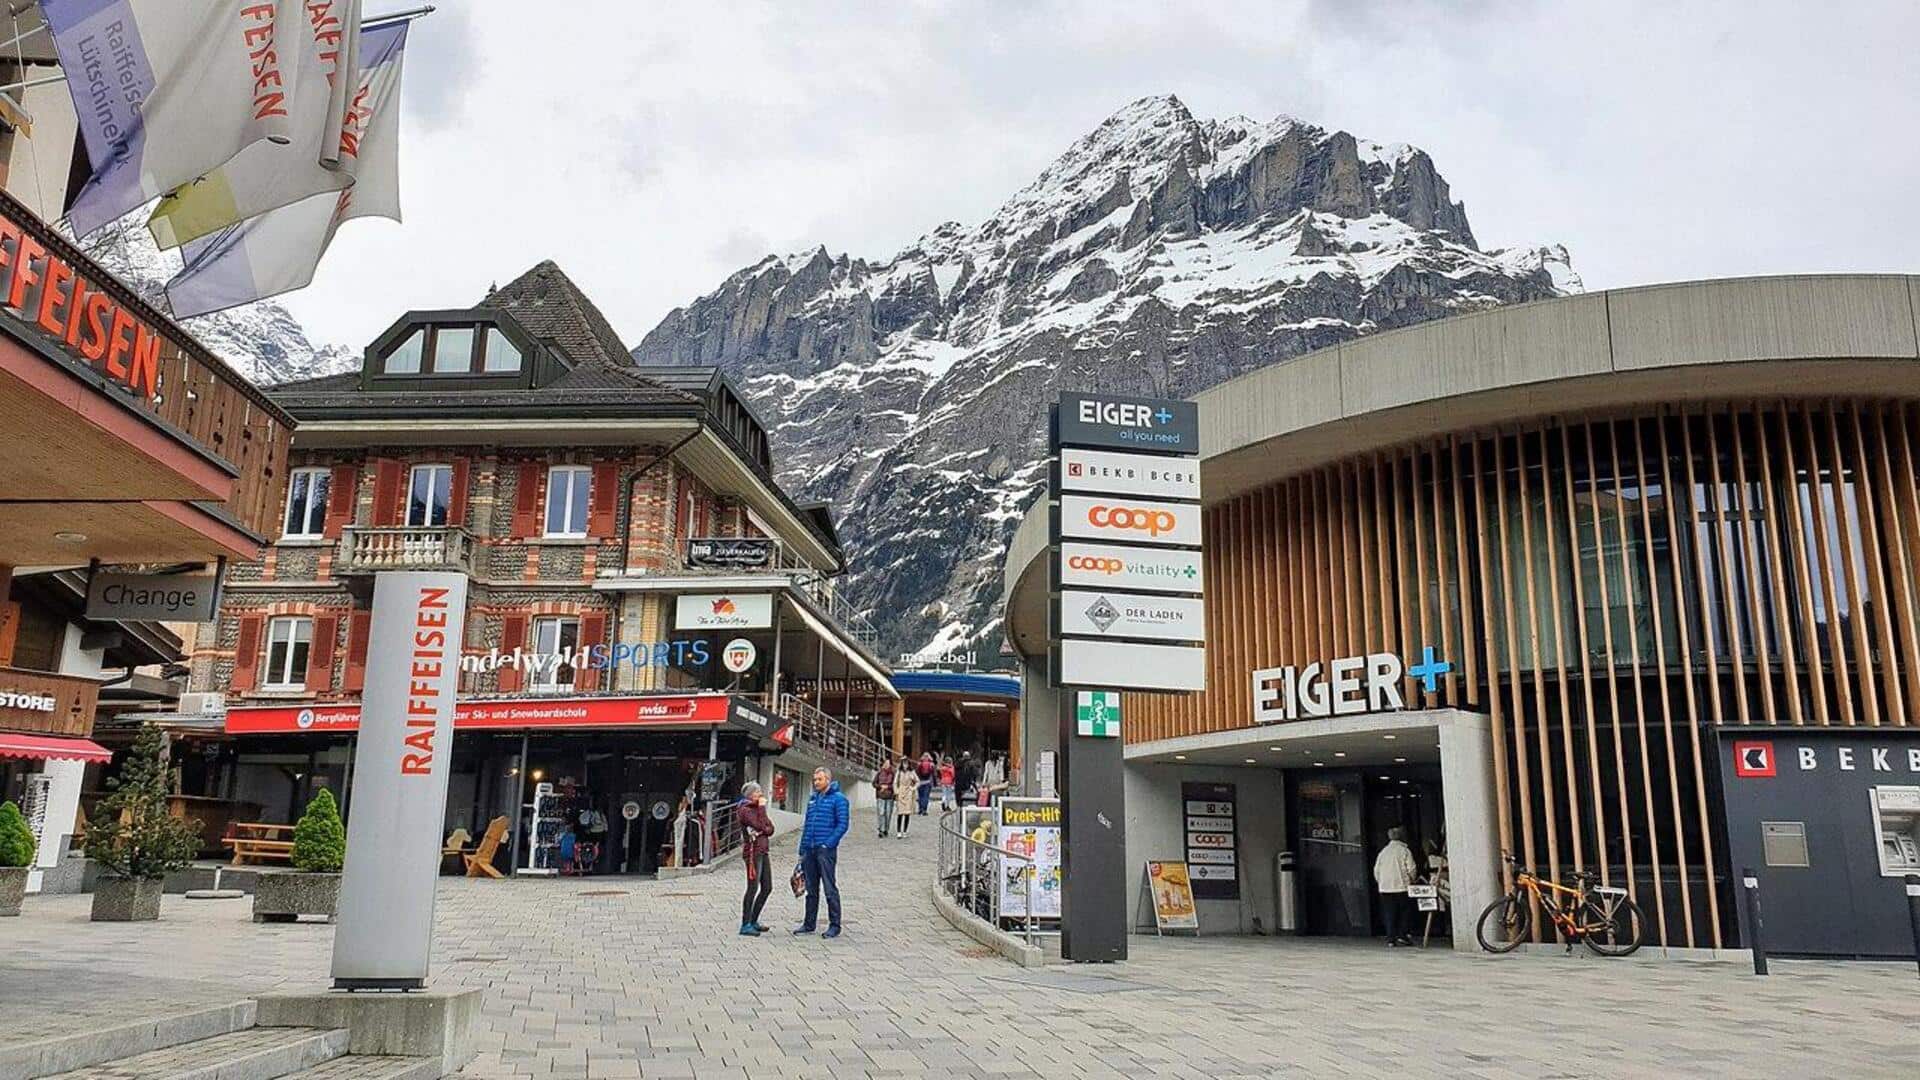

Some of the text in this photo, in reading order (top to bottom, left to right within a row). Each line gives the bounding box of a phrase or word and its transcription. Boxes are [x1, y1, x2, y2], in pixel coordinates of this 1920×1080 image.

[1119, 430, 1181, 444] all you need
[1088, 505, 1176, 537] coop
[1068, 555, 1180, 578] coop vitality
[102, 584, 196, 611] Change
[1126, 608, 1183, 620] DER LADEN
[401, 588, 449, 775] RAIFFEISEN
[0, 691, 57, 712] STORE
[492, 710, 509, 719] und
